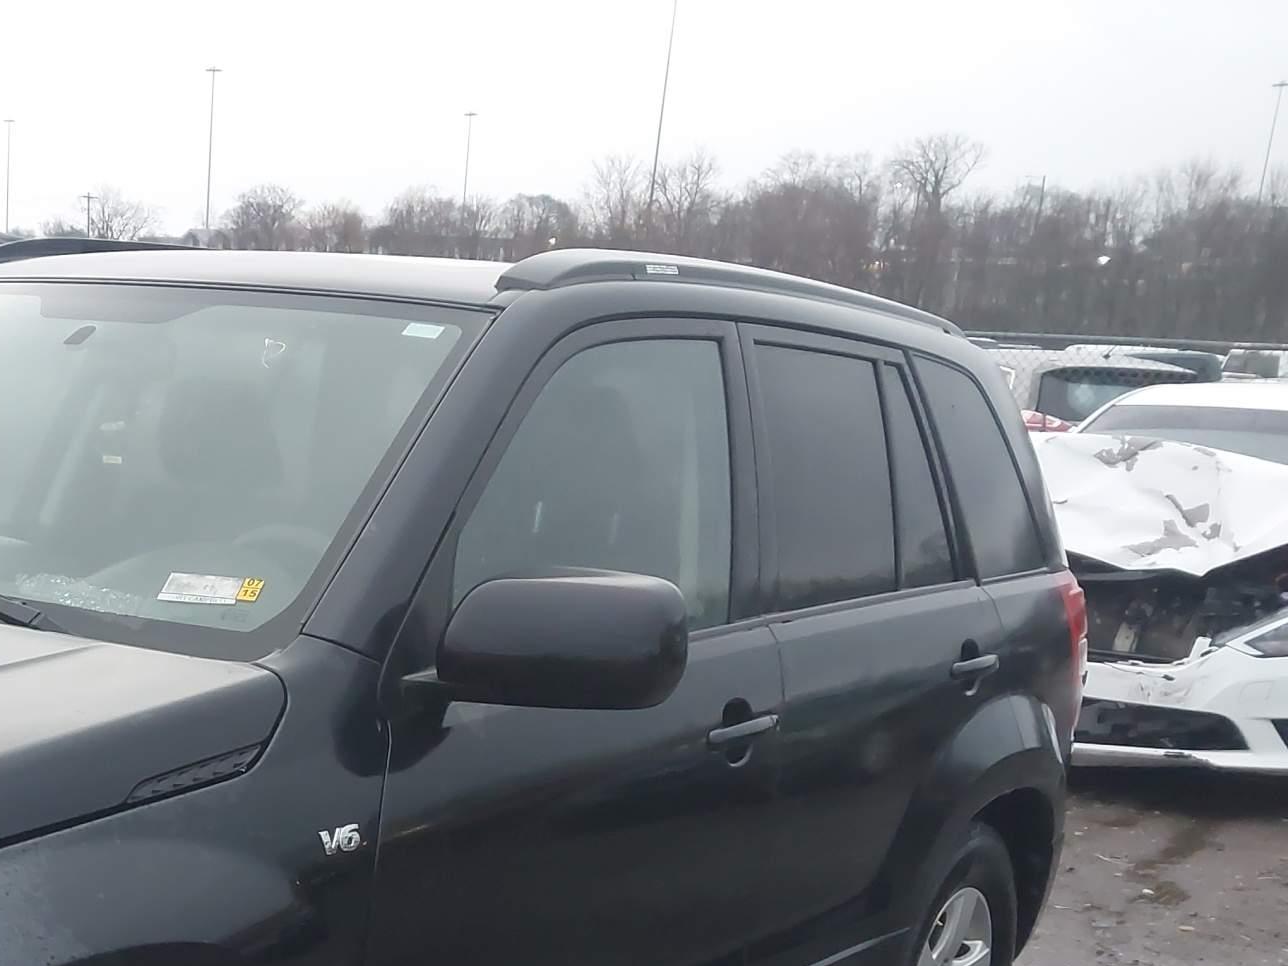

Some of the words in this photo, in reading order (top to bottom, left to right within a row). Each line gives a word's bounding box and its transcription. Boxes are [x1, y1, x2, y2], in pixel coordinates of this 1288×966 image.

[247, 578, 263, 587] 07
[242, 589, 257, 598] 15
[317, 823, 361, 855] V6
